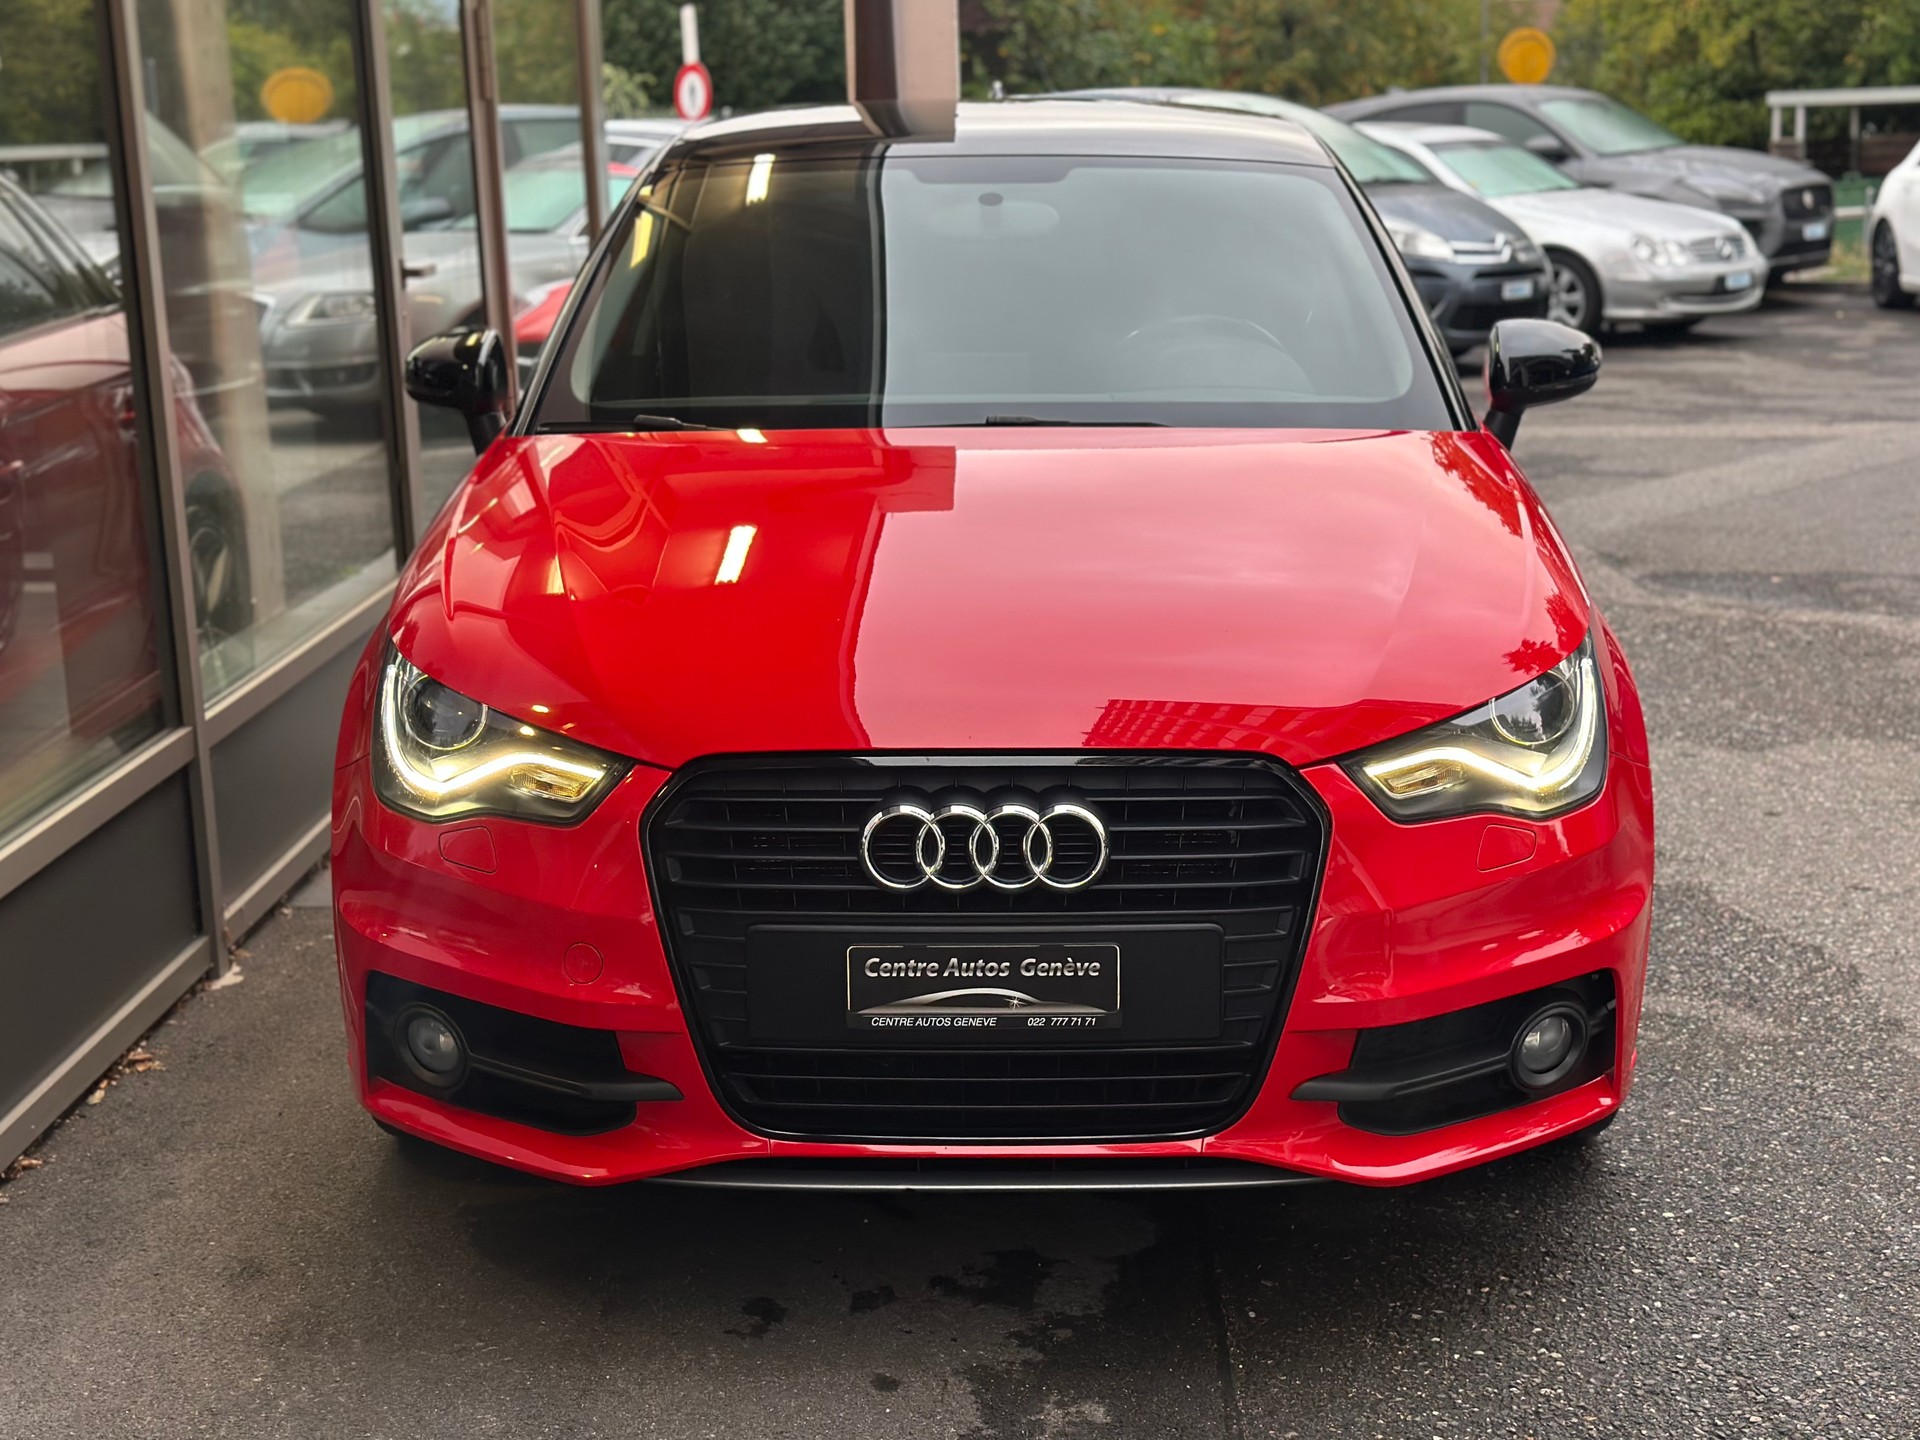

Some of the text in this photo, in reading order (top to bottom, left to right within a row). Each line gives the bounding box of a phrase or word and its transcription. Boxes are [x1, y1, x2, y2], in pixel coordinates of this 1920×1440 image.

[864, 957, 1101, 978] Centre Autos Genève
[871, 1017, 998, 1027] CENTRE AUTOS GENEVE
[1027, 1017, 1097, 1027] 022 777 71 71
